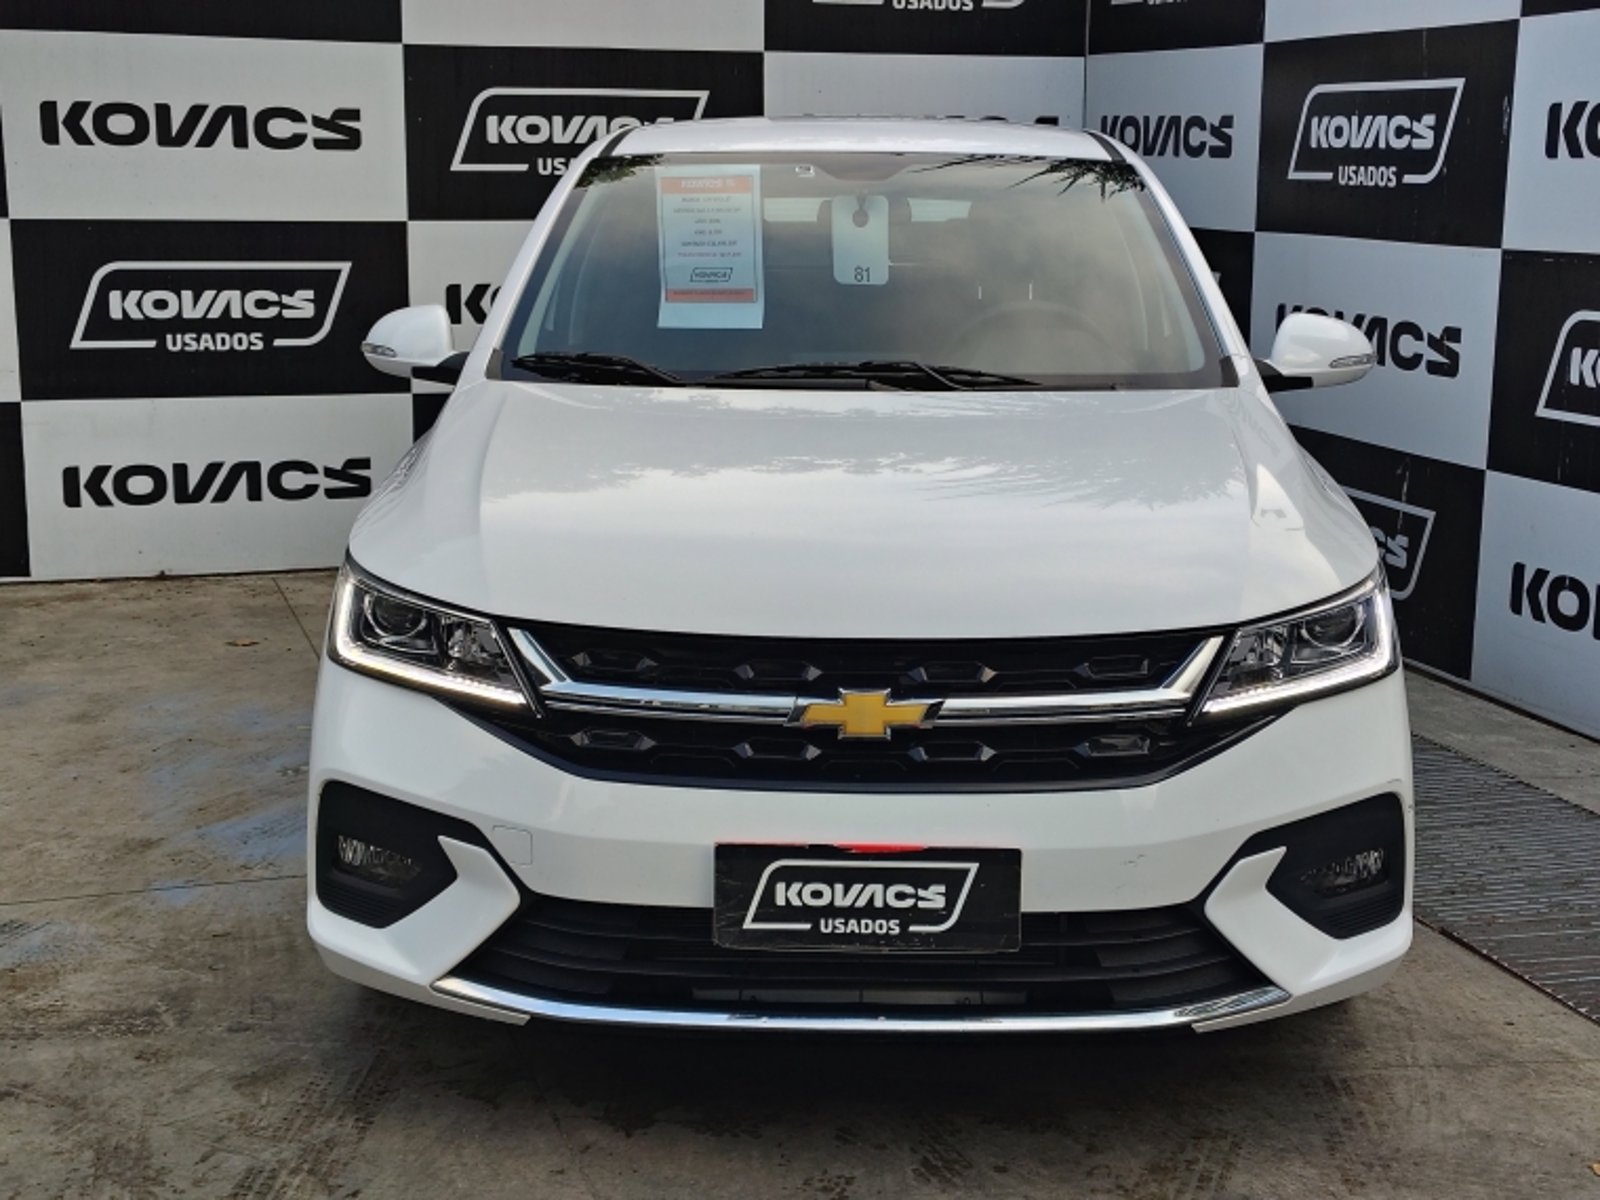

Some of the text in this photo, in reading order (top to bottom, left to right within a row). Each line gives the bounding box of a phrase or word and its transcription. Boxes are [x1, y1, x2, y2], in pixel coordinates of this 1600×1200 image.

[40, 100, 362, 151] KOVACS
[1310, 114, 1436, 149] KOVACS
[1338, 165, 1397, 187] USADOS
[853, 265, 871, 283] 81
[109, 290, 315, 320] KOVACS
[166, 332, 264, 352] USADOS
[62, 456, 372, 508] KOVACS
[775, 882, 946, 909] KOVACS
[820, 918, 900, 935] USADOS
